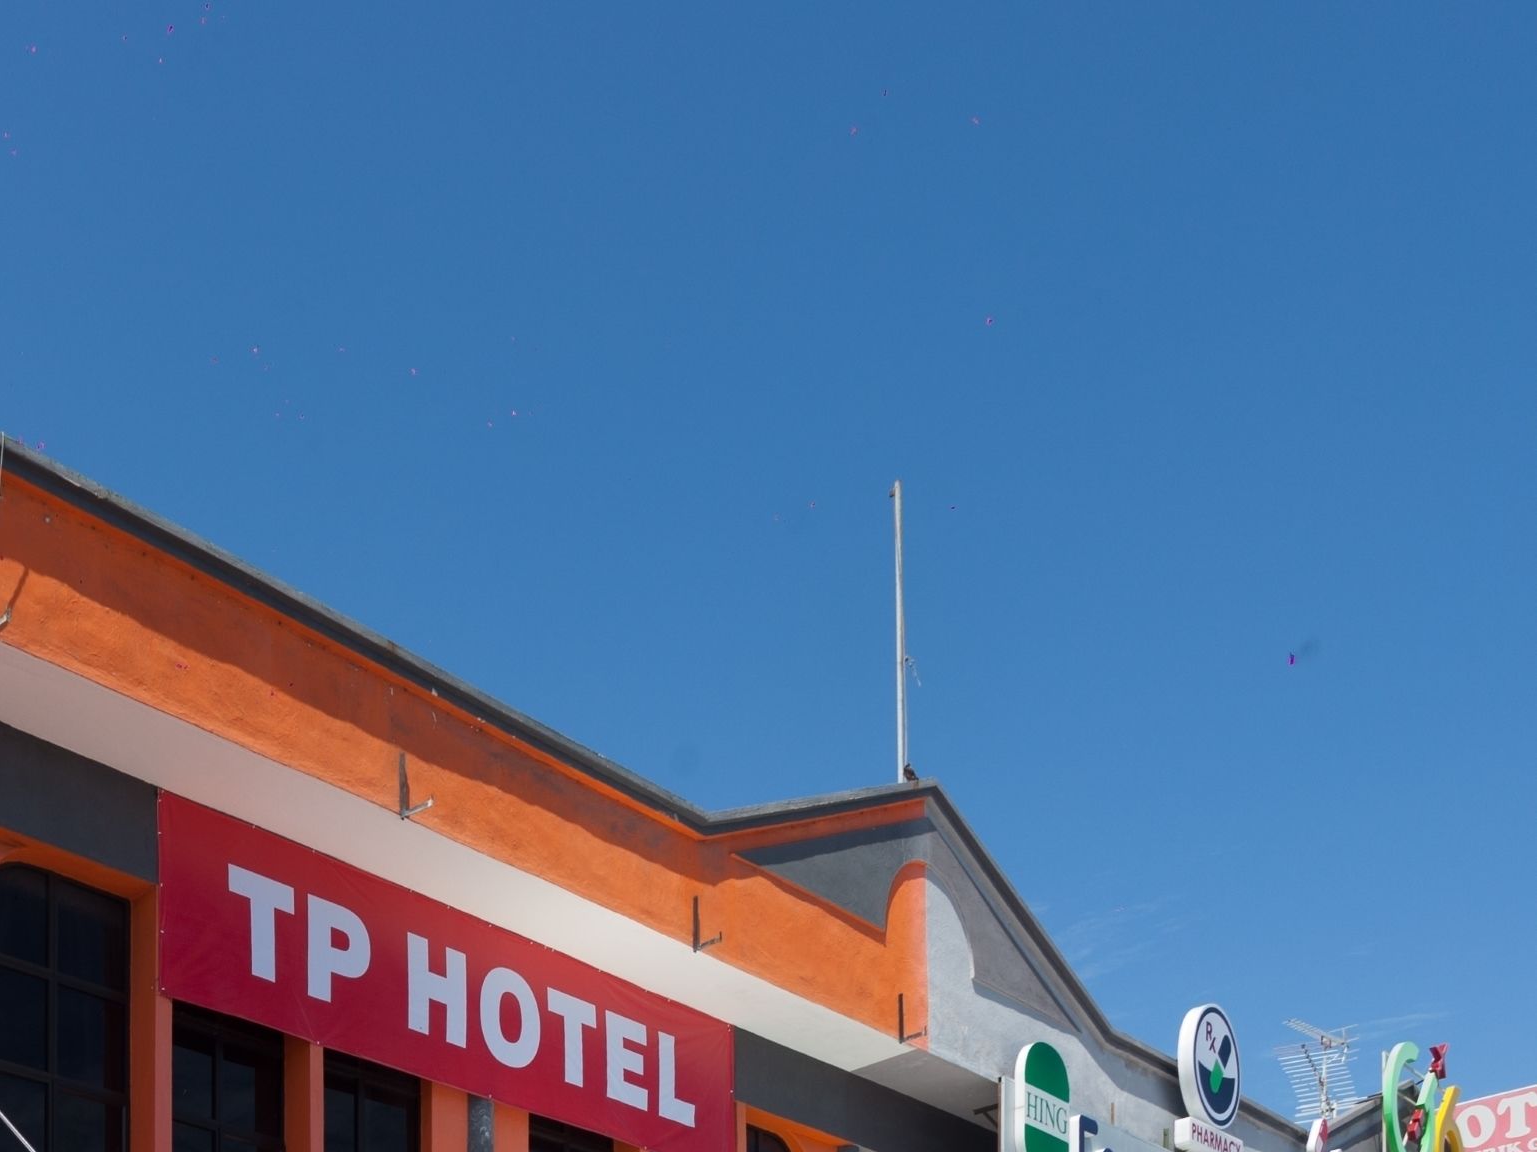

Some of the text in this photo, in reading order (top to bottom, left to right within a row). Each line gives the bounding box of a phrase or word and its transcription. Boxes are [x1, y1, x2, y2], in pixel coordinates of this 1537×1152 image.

[227, 863, 695, 1128] TP HOTEL
[1026, 1092, 1067, 1135] HING
